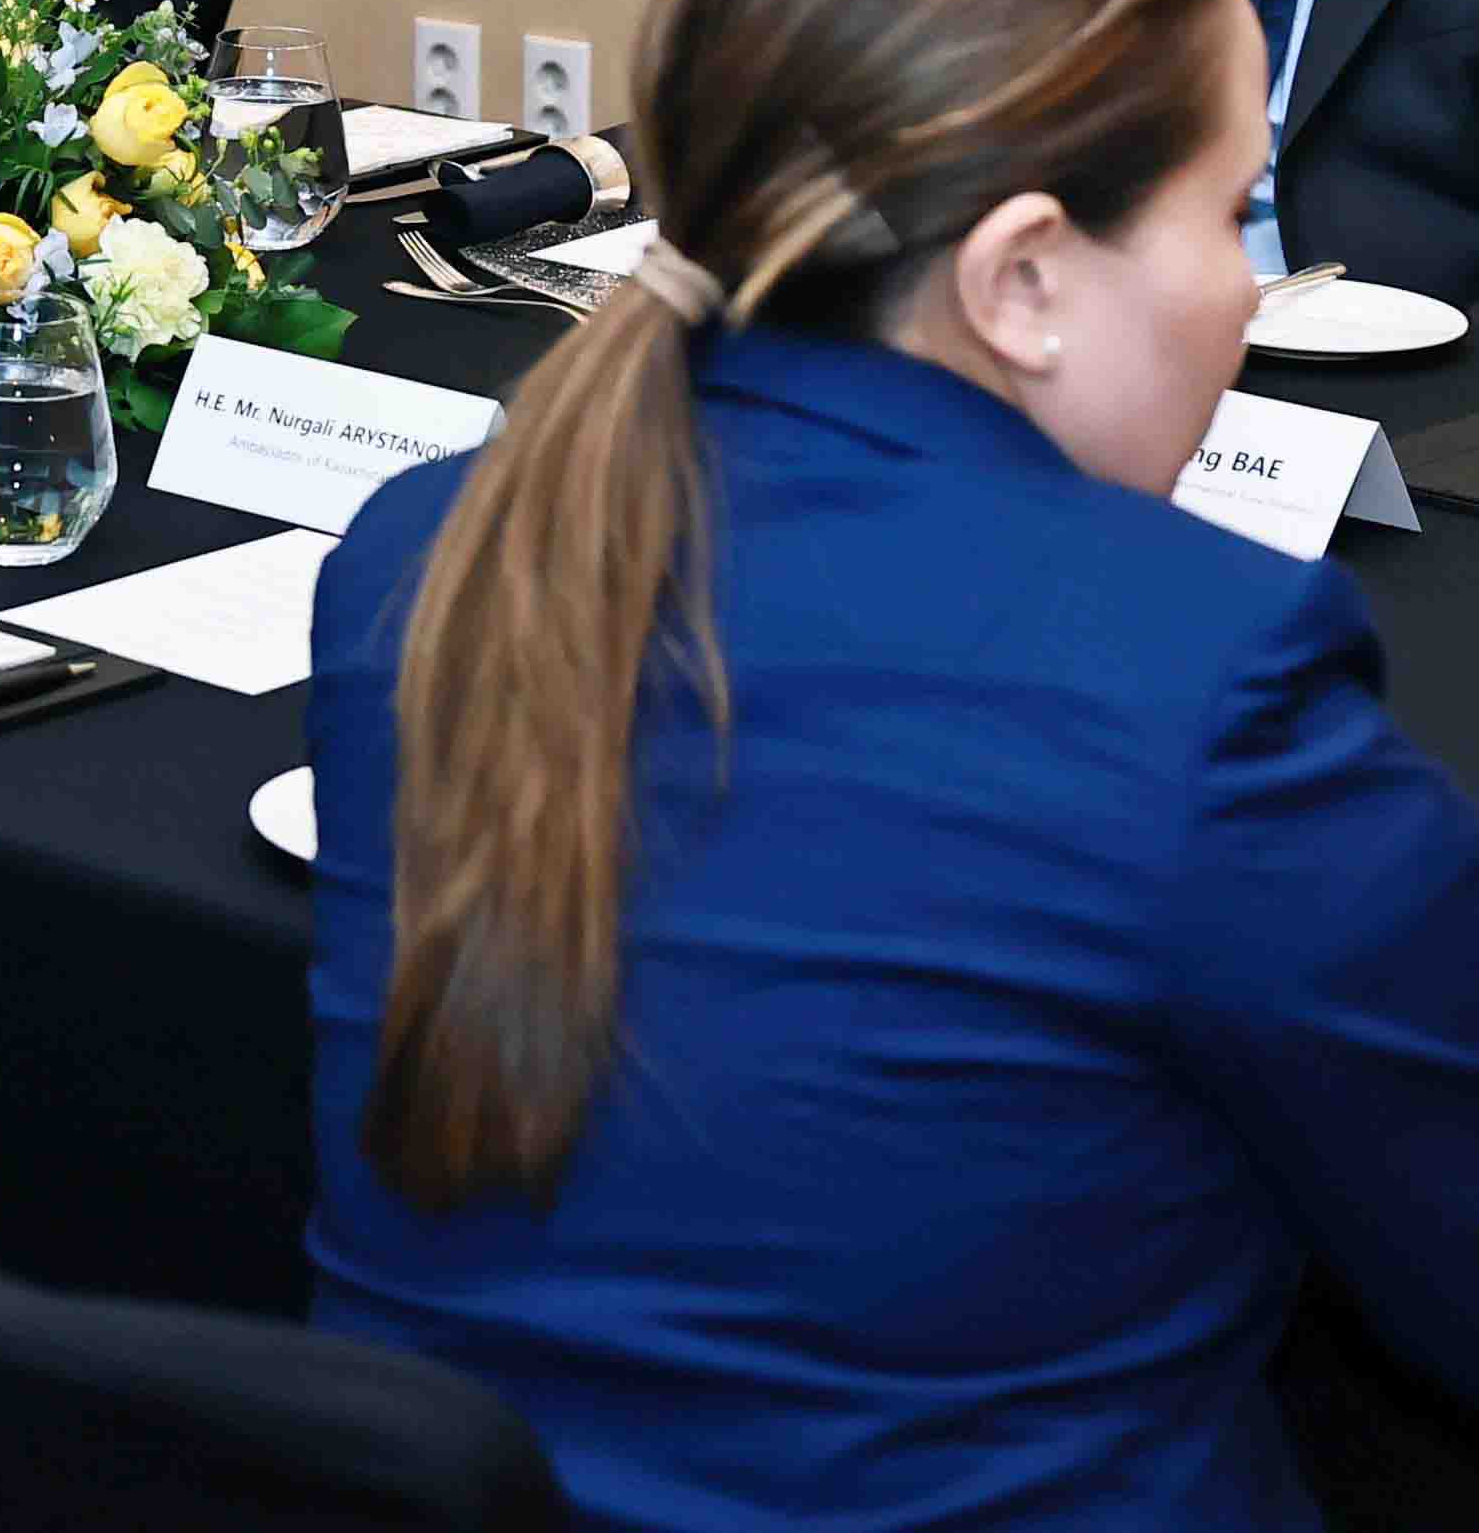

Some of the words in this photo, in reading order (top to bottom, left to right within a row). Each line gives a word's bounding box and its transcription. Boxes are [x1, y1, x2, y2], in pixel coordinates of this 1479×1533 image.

[194, 388, 226, 413] H.E.
[233, 398, 260, 421] Mr.
[268, 406, 335, 438] Nurgali
[1232, 451, 1284, 479] BAE
